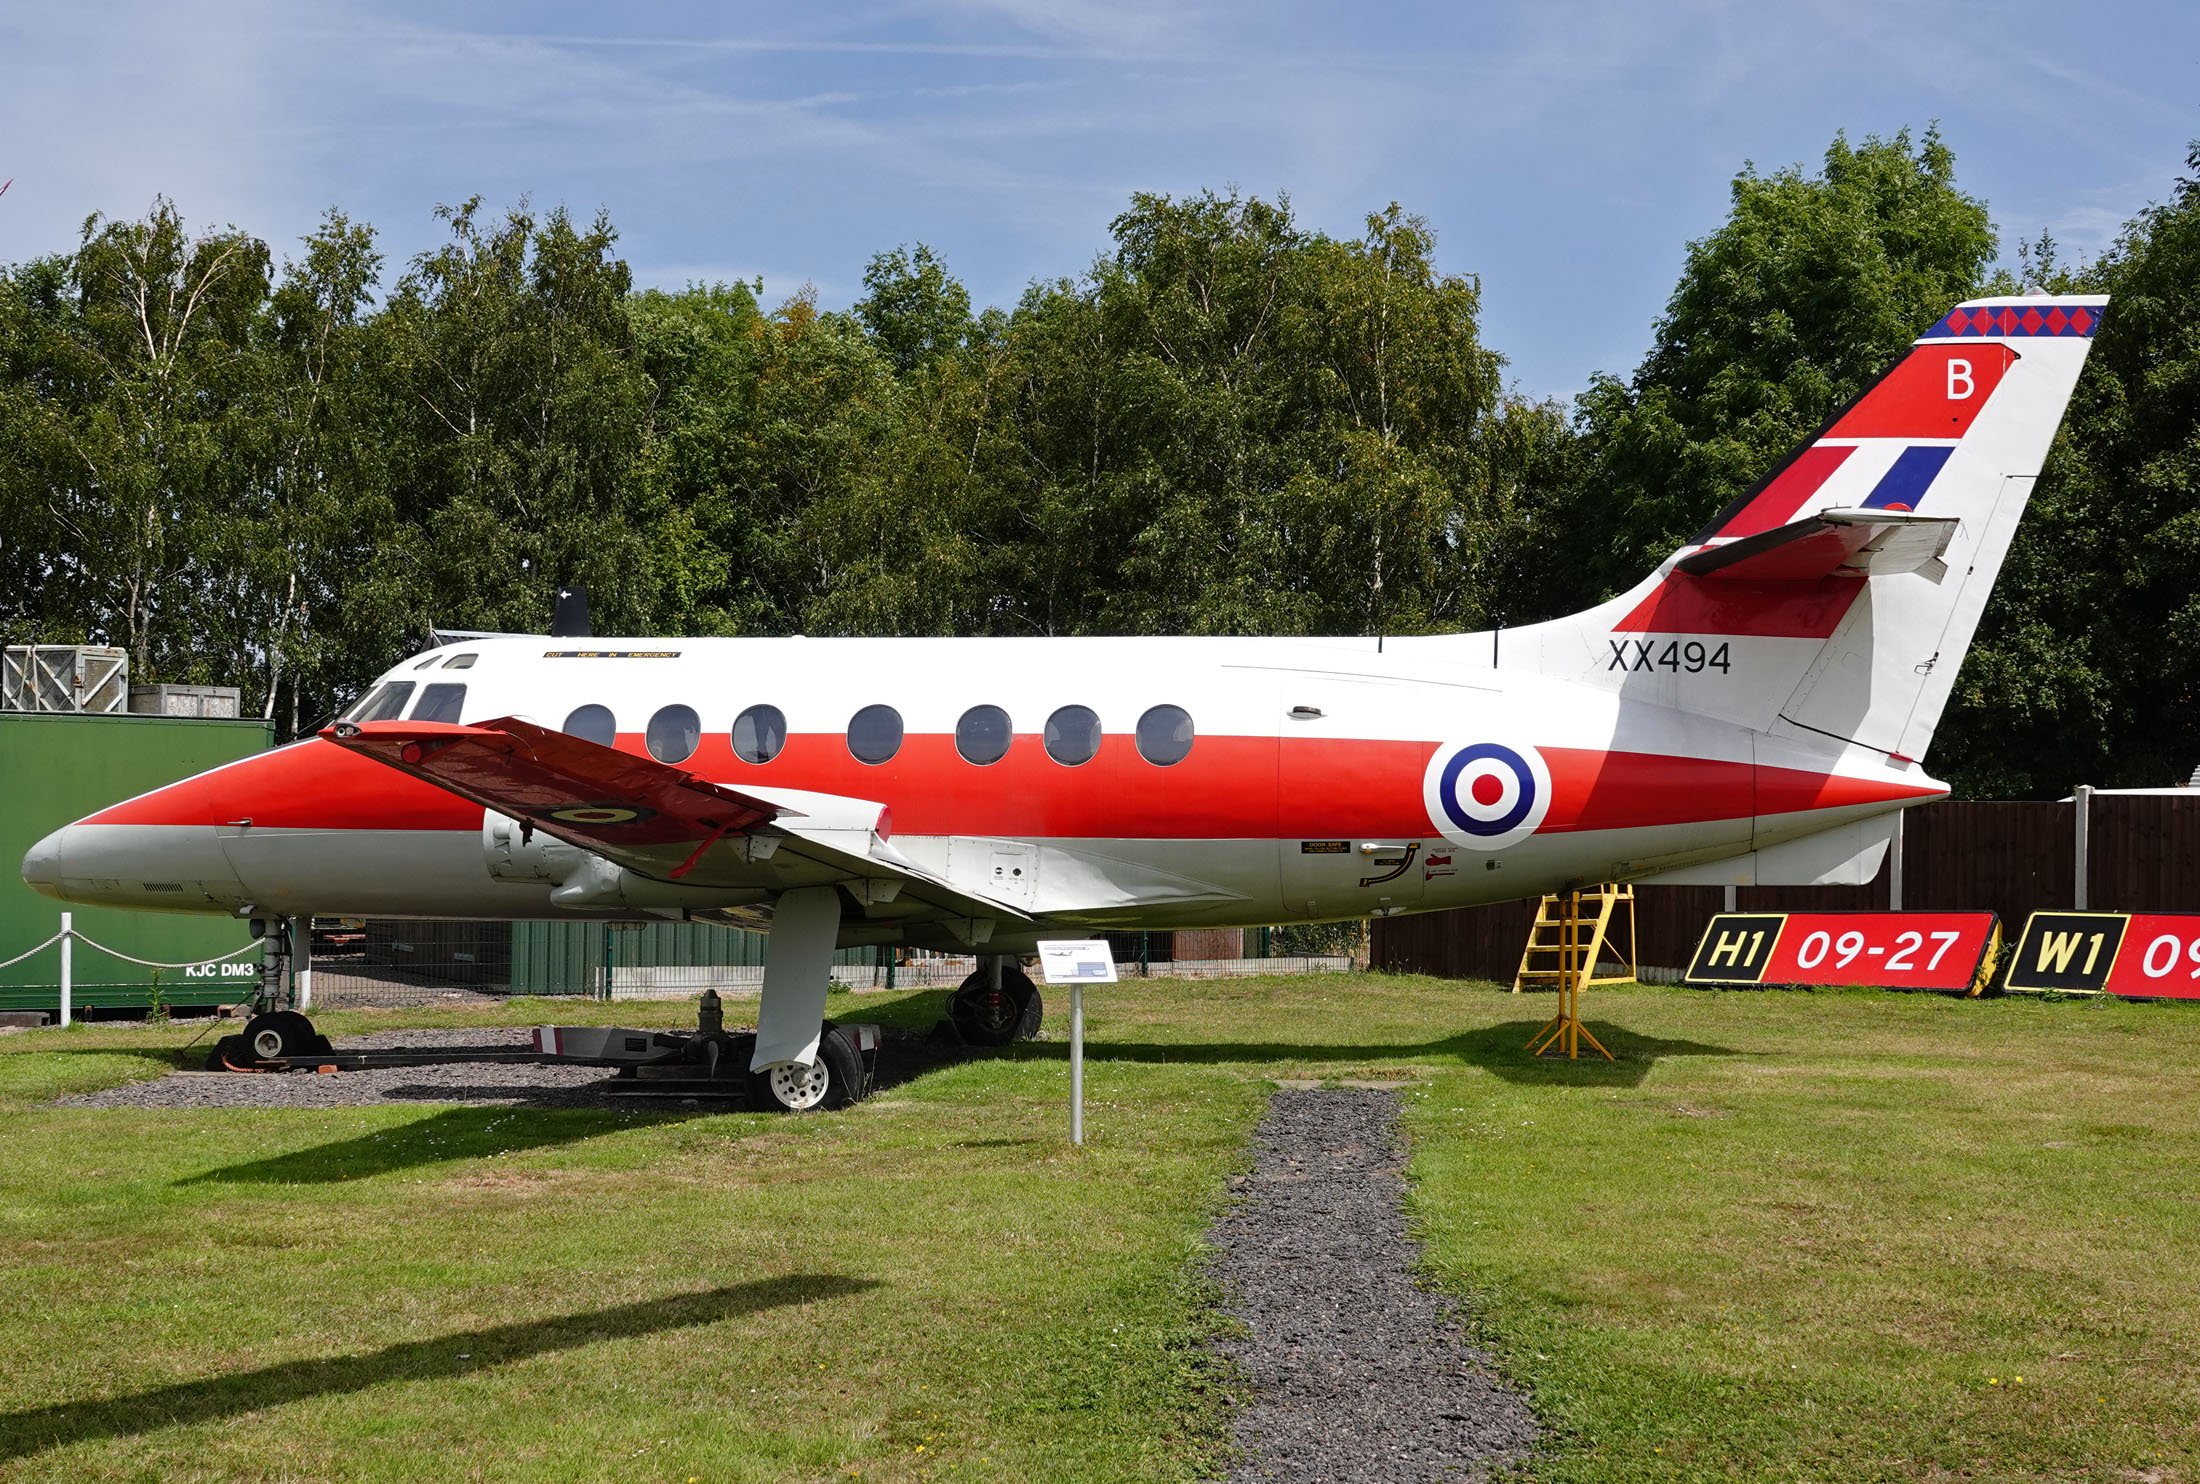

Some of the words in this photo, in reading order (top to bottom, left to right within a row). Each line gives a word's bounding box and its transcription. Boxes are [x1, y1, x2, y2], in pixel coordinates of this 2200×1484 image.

[1947, 359, 1975, 400] B
[1608, 640, 1731, 674] XX494
[186, 963, 216, 976] KJC
[221, 963, 254, 976] DM3
[1708, 930, 1765, 967] H1
[1797, 931, 1960, 970] 09-27
[2036, 931, 2105, 975] W1
